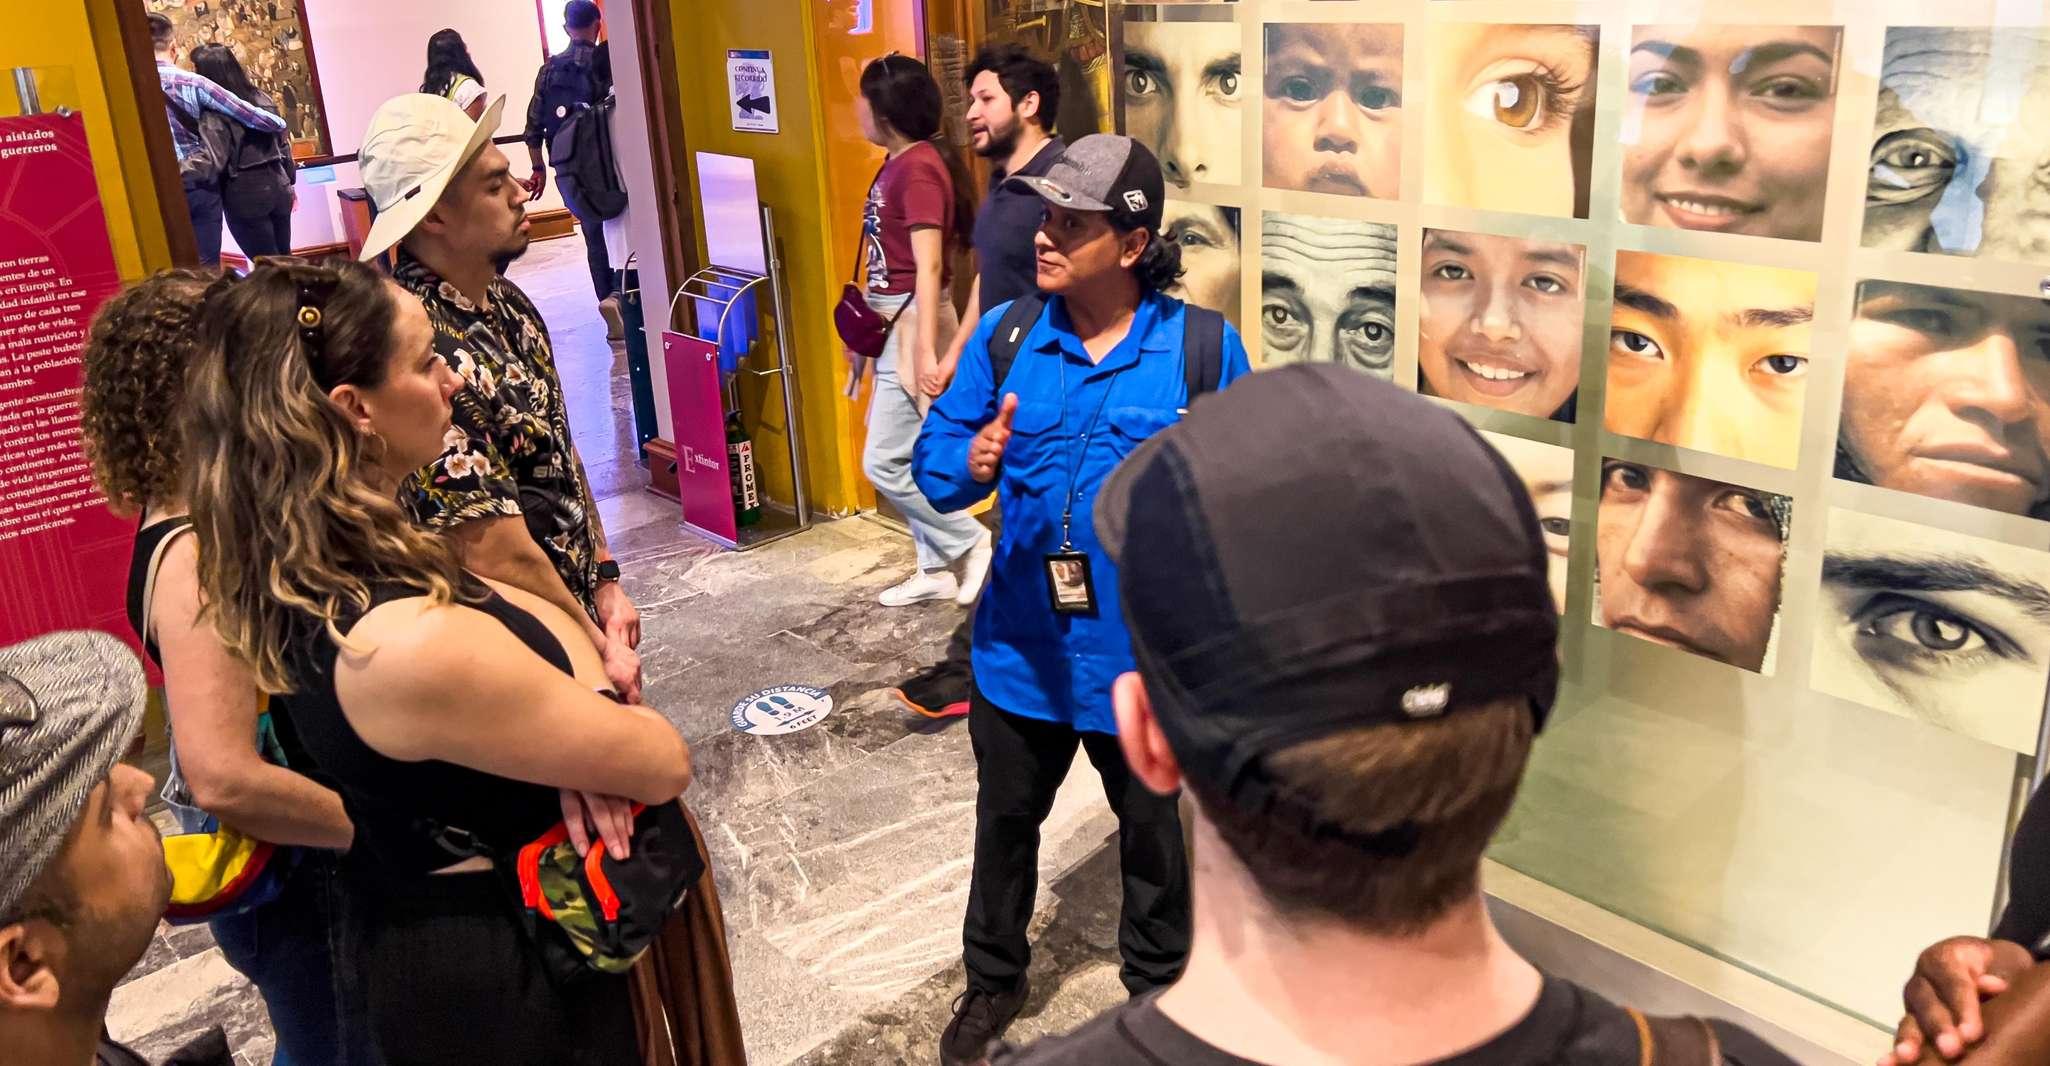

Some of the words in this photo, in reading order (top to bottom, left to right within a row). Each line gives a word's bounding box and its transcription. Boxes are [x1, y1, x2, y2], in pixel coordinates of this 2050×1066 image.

[5, 129, 55, 142] aislados
[1, 143, 57, 159] guerreros
[18, 256, 49, 266] tierras
[28, 269, 40, 278] de
[42, 268, 55, 276] un
[59, 277, 72, 286] En
[20, 292, 56, 306] infantil
[57, 292, 70, 300] en
[71, 290, 87, 298] ese
[3, 314, 22, 322] uno
[24, 310, 36, 319] de
[39, 306, 61, 316] cada
[63, 304, 80, 312] tres
[18, 324, 36, 334] año
[38, 321, 50, 330] de
[52, 317, 76, 328] vida,
[8, 337, 32, 349] mala
[34, 330, 78, 344] nutrición
[80, 328, 86, 338] y
[12, 352, 24, 362] La
[26, 348, 52, 361] peste
[22, 364, 31, 373] la
[33, 356, 82, 374] población,
[22, 410, 34, 418] en
[36, 406, 45, 415] la
[22, 422, 34, 431] en
[36, 420, 50, 428] las
[4, 436, 34, 448] contra
[36, 432, 50, 440] los
[27, 446, 46, 458] que
[48, 441, 68, 452] más
[5, 457, 58, 474] continente.
[12, 474, 34, 485] vida
[36, 463, 88, 479] imperantes
[6, 478, 78, 500] conquistadores
[78, 474, 91, 483] de
[15, 496, 58, 510] buscaron
[60, 488, 86, 500] mejor
[23, 512, 40, 522] con
[42, 508, 51, 516] el
[52, 504, 70, 516] que
[72, 502, 82, 510] se
[20, 517, 76, 535] americanos.
[732, 701, 747, 727] GUARDE
[745, 693, 760, 702] SU
[761, 686, 821, 697] DISTANCIA
[796, 714, 818, 727] FEET
